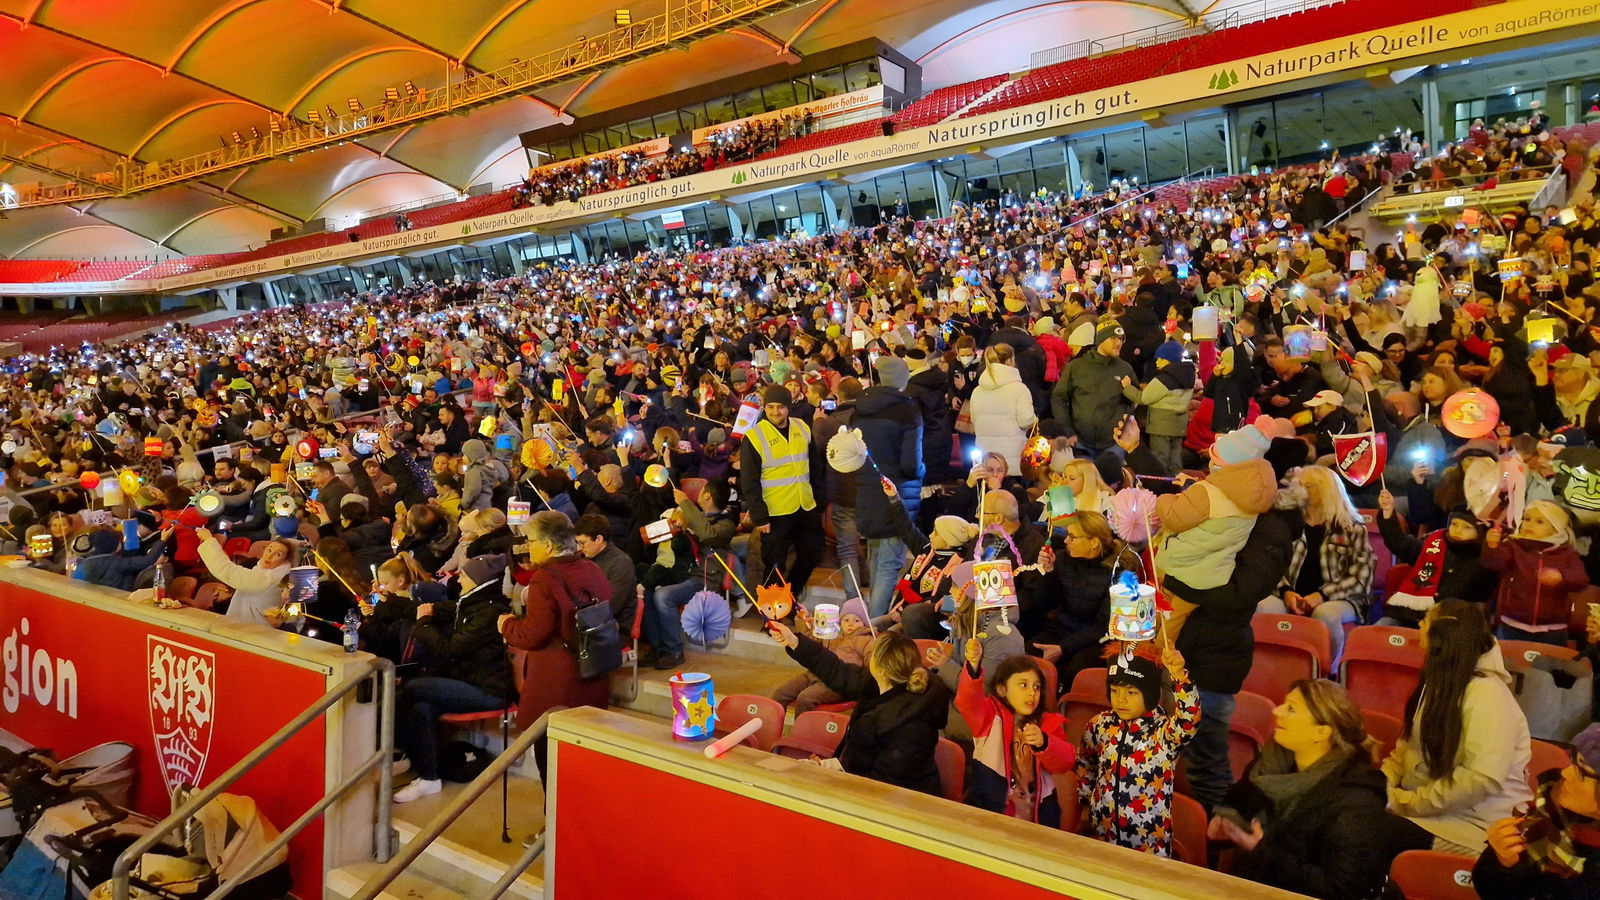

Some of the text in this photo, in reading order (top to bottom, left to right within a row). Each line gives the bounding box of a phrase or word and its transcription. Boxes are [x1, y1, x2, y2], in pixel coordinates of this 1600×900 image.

[1246, 3, 1600, 81] Naturpark Quelle von aquaRömer
[928, 90, 1138, 144] Natursprünglich gut.
[750, 140, 920, 180] Naturpark Quelle von aquaRömer
[579, 181, 695, 211] Natursprünglich gut.
[472, 217, 508, 231] Naturpark
[509, 211, 534, 225] Quelle
[362, 230, 439, 251] Natursprünglich gut.
[214, 263, 256, 278] Natursprünglich
[1280, 622, 1290, 630] 25
[3, 617, 78, 719] gion
[162, 716, 171, 731] 18
[188, 726, 198, 742] 93
